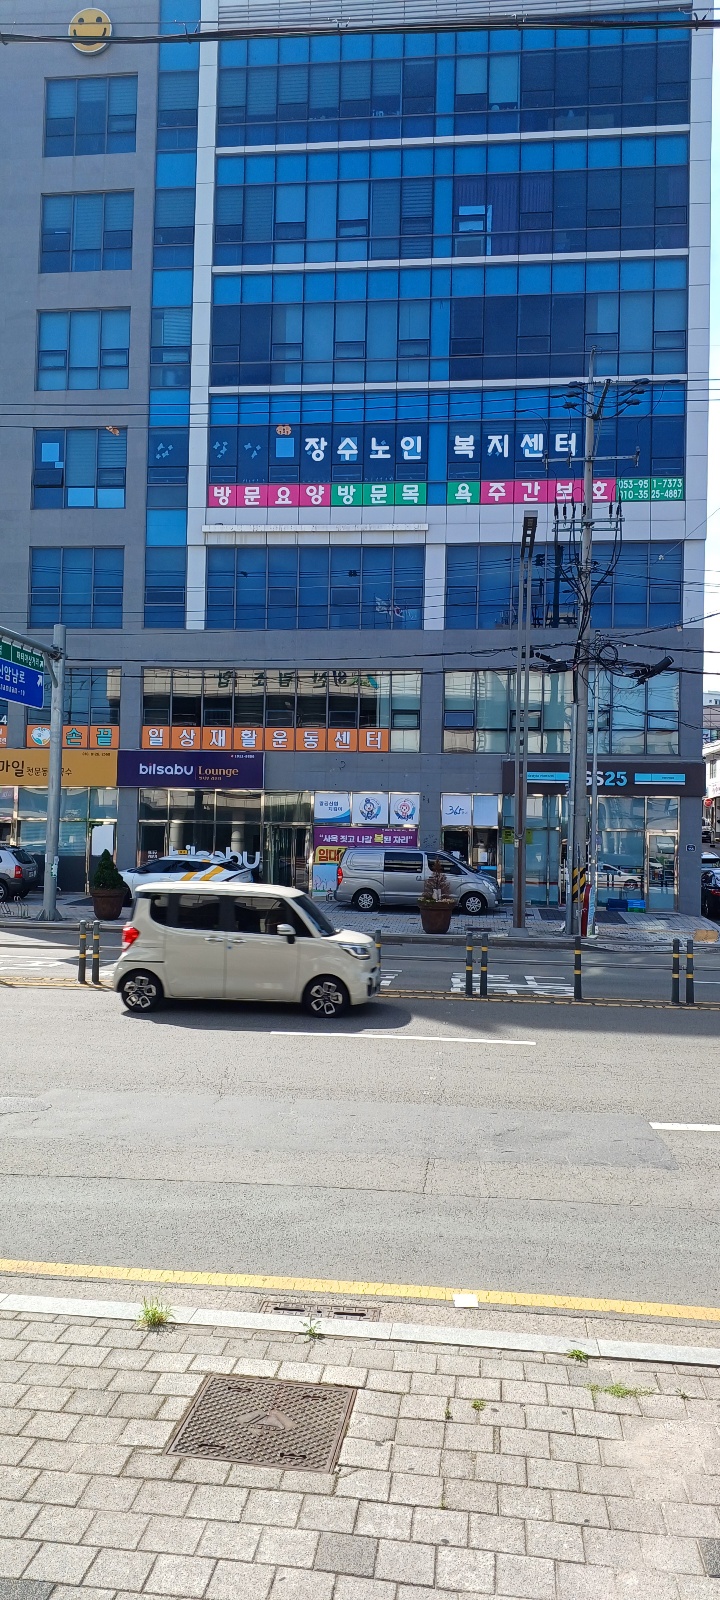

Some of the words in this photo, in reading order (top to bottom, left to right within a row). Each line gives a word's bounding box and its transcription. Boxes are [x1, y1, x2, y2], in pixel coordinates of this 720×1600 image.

[304, 435, 422, 462] 장수노인
[453, 432, 577, 459] 복지센터
[213, 484, 325, 506] 방문요양
[488, 481, 608, 502] 주간보호
[66, 727, 113, 747] 손끝
[147, 727, 382, 749] 일상재활운동센터
[139, 763, 194, 775] bilsabu
[198, 766, 239, 778] Lounge
[585, 770, 628, 787] GS25
[339, 834, 355, 843] 짓고
[356, 835, 373, 844] 나갈
[373, 833, 392, 844] 복된
[318, 848, 340, 862] 임대
